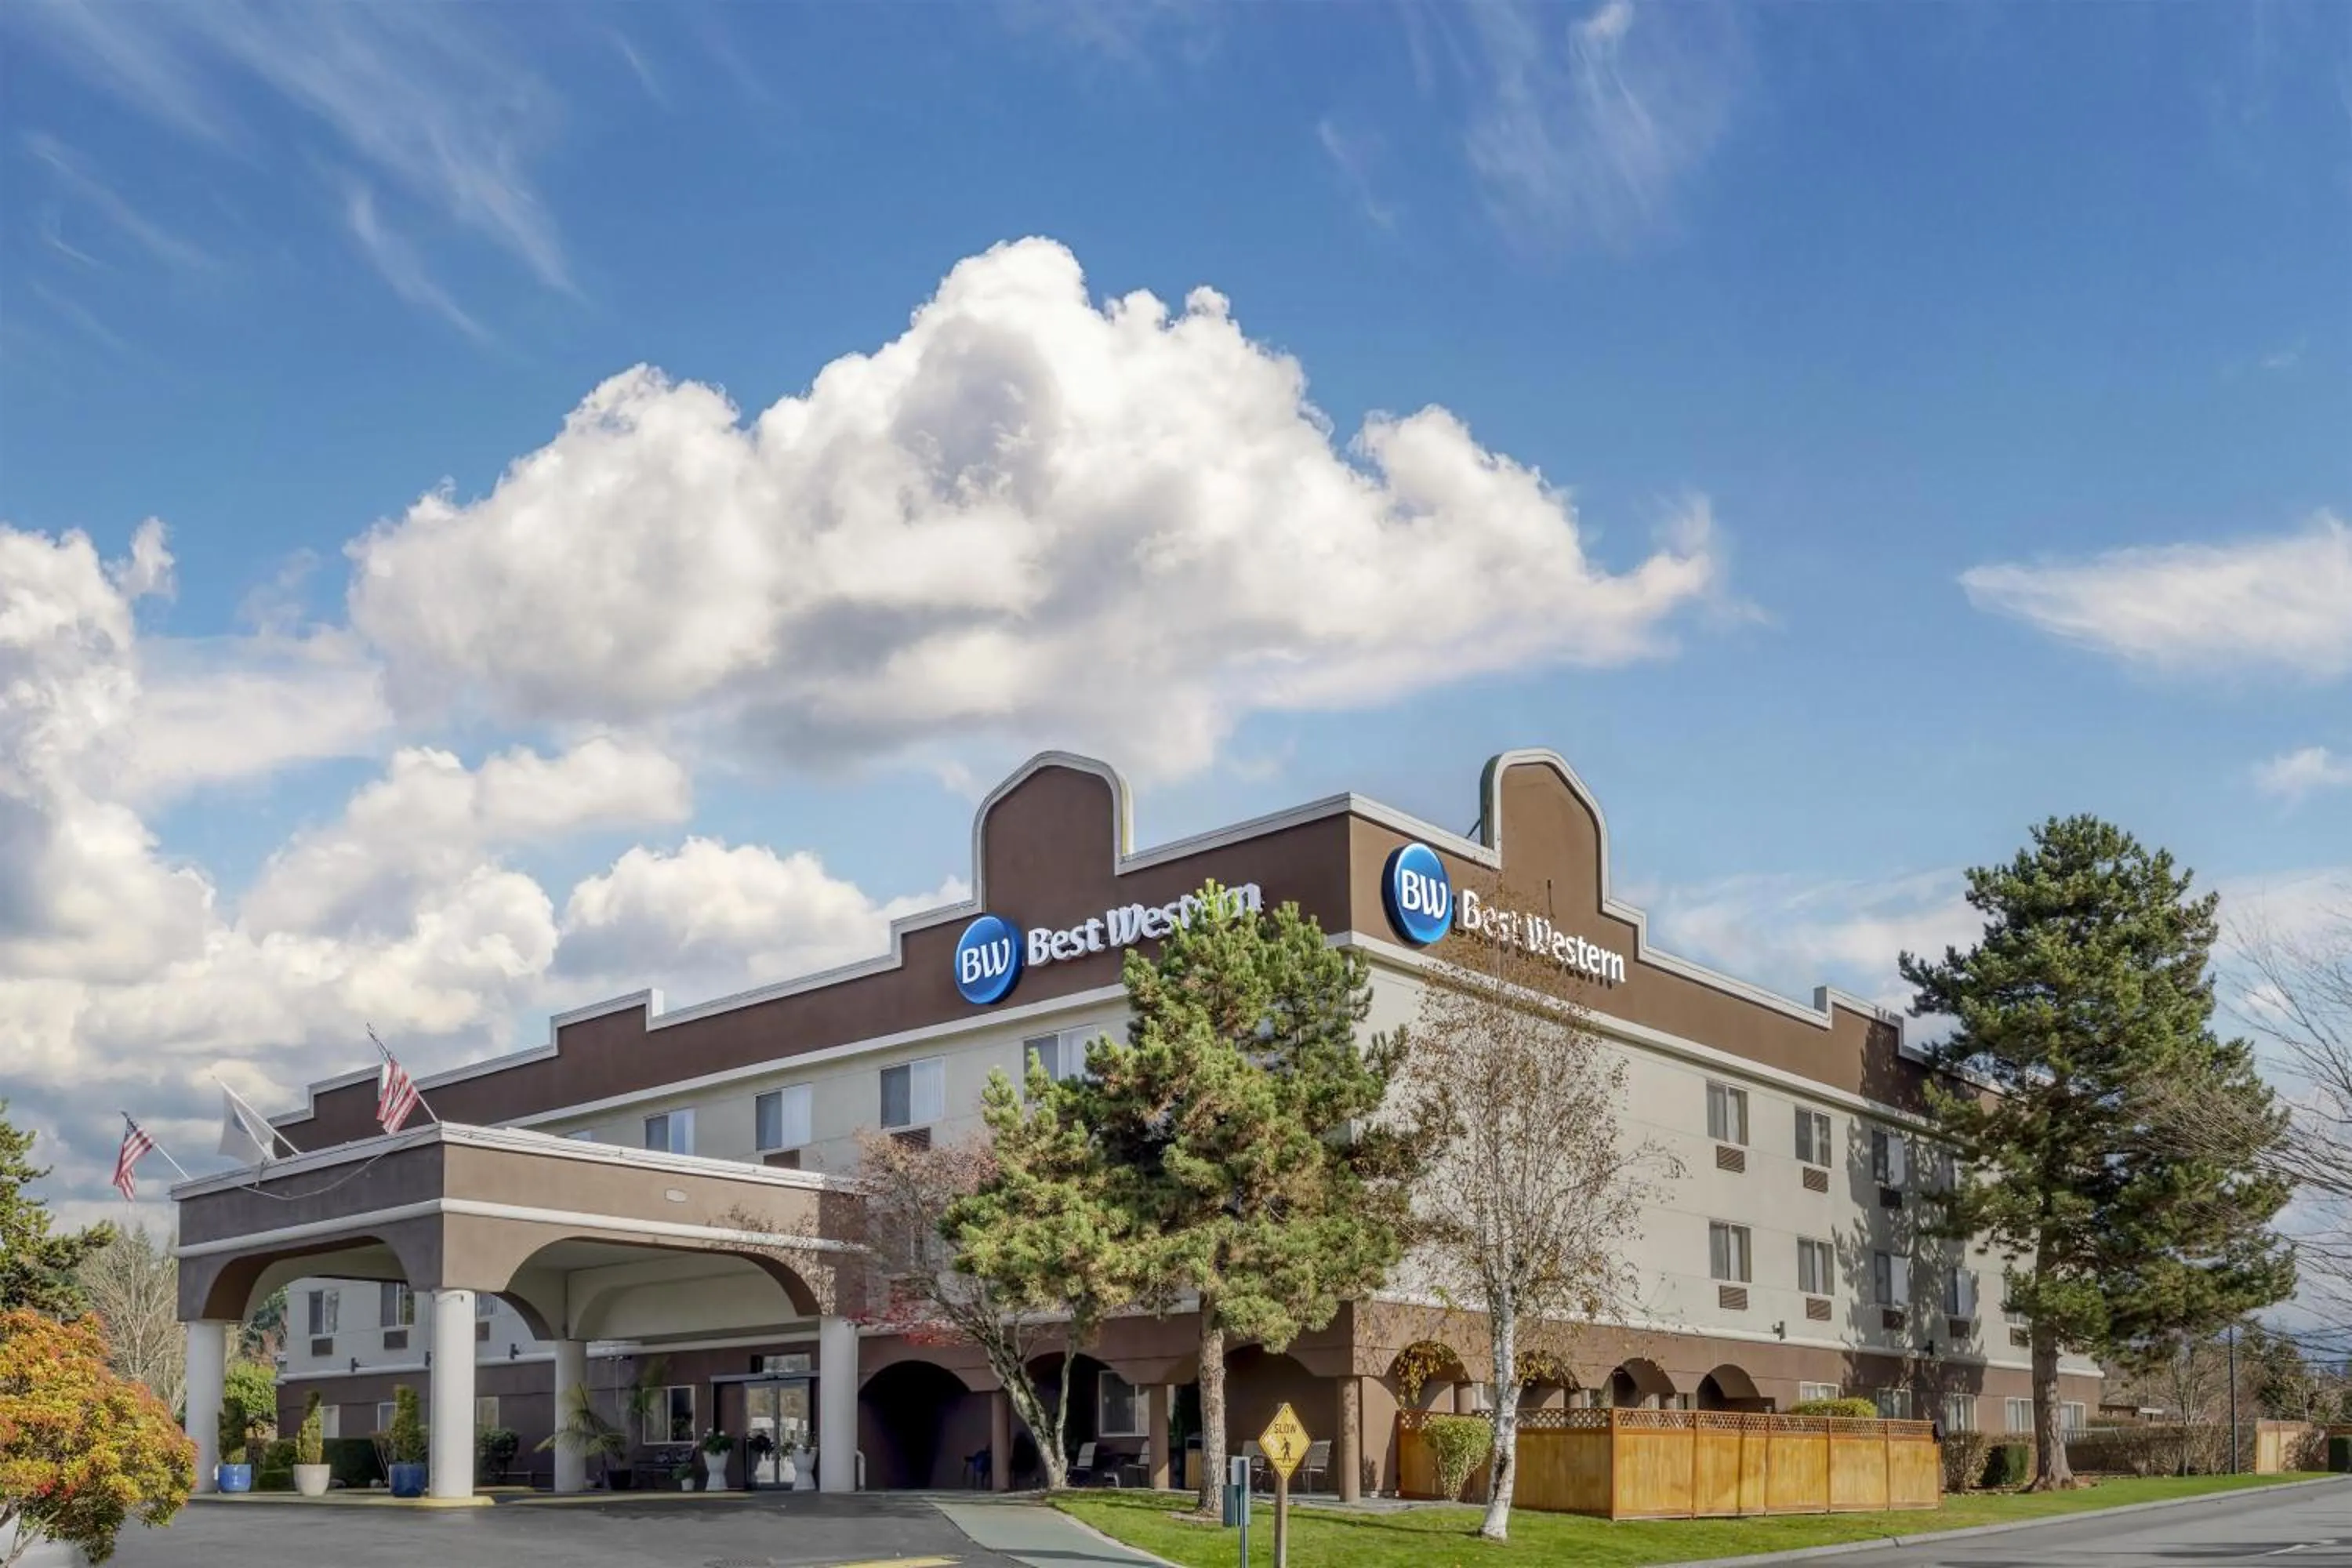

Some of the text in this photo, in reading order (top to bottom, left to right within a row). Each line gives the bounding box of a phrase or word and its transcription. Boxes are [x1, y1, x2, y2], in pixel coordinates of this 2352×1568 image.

[1400, 869, 1448, 920] BW
[1028, 882, 1263, 966] Best Westrn
[1461, 888, 1627, 983] Best Western
[960, 937, 1011, 984] BW
[1274, 1423, 1298, 1434] SLOW
